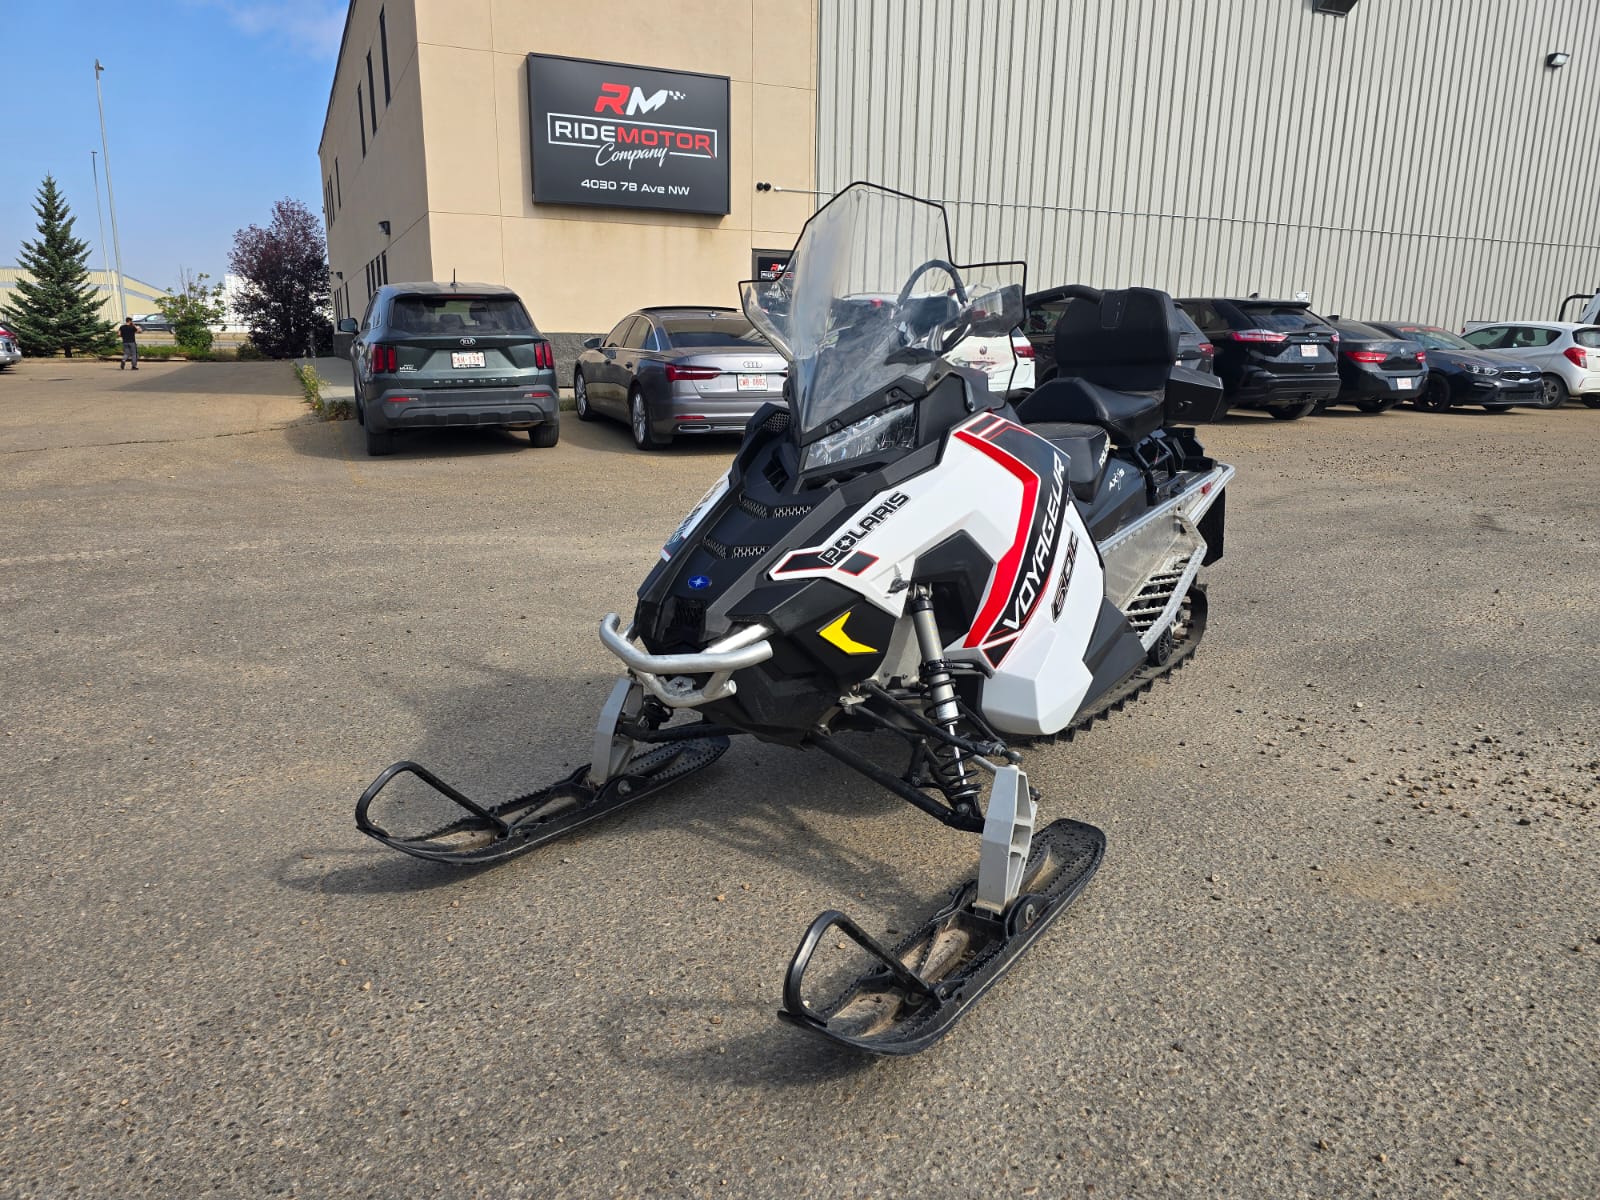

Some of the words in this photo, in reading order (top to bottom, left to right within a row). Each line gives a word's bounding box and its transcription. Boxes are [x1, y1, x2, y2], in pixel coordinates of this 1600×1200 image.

[594, 82, 669, 116] RM
[595, 142, 667, 170] Company
[580, 179, 617, 190] 4030
[620, 181, 638, 192] 78
[641, 183, 665, 194] Ave
[668, 185, 690, 196] NW
[818, 490, 910, 566] POLARIS
[1002, 450, 1065, 630] VOYAGEUR
